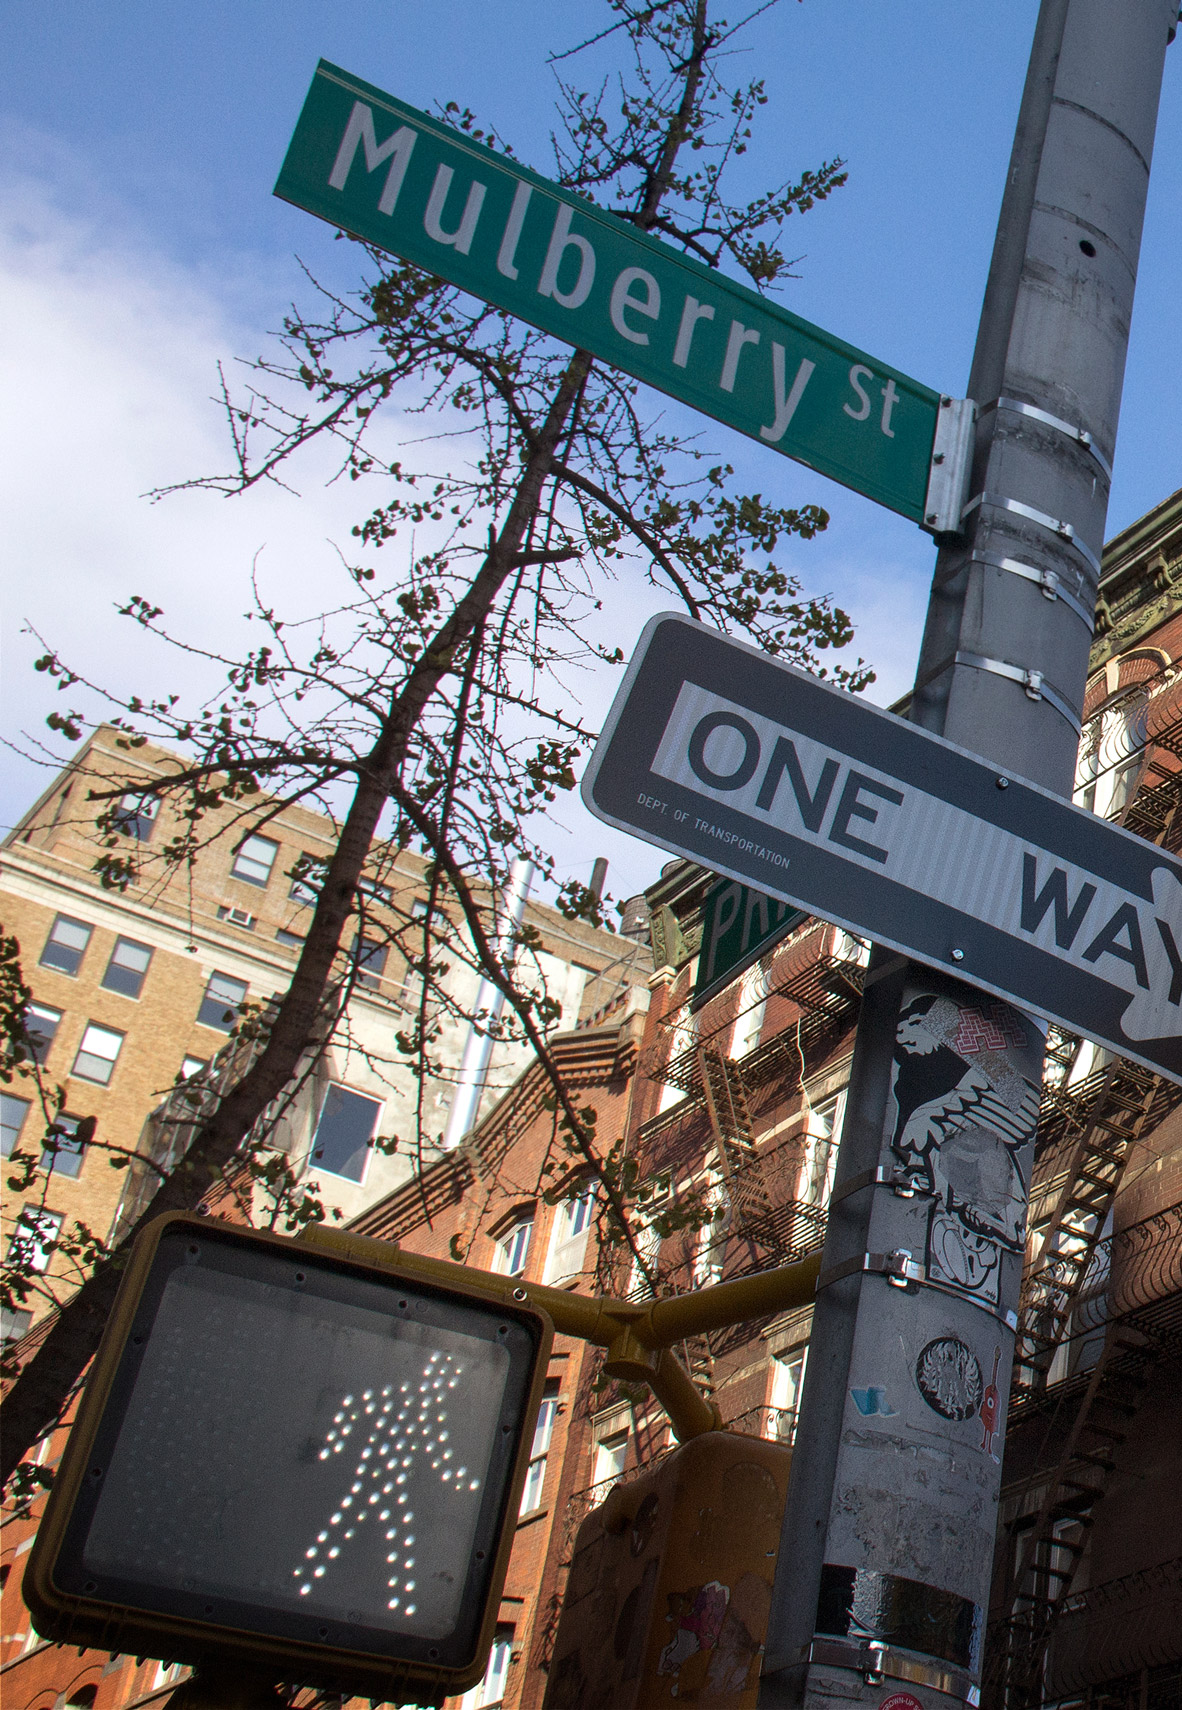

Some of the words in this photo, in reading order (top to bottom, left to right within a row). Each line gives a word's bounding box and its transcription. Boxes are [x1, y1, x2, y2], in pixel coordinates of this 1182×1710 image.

[327, 100, 816, 442] Mulberry
[842, 364, 899, 438] St
[637, 793, 668, 816] DEPT.
[674, 809, 690, 823] OF
[694, 818, 790, 869] TRANSPORTATION
[688, 710, 904, 865] ONE
